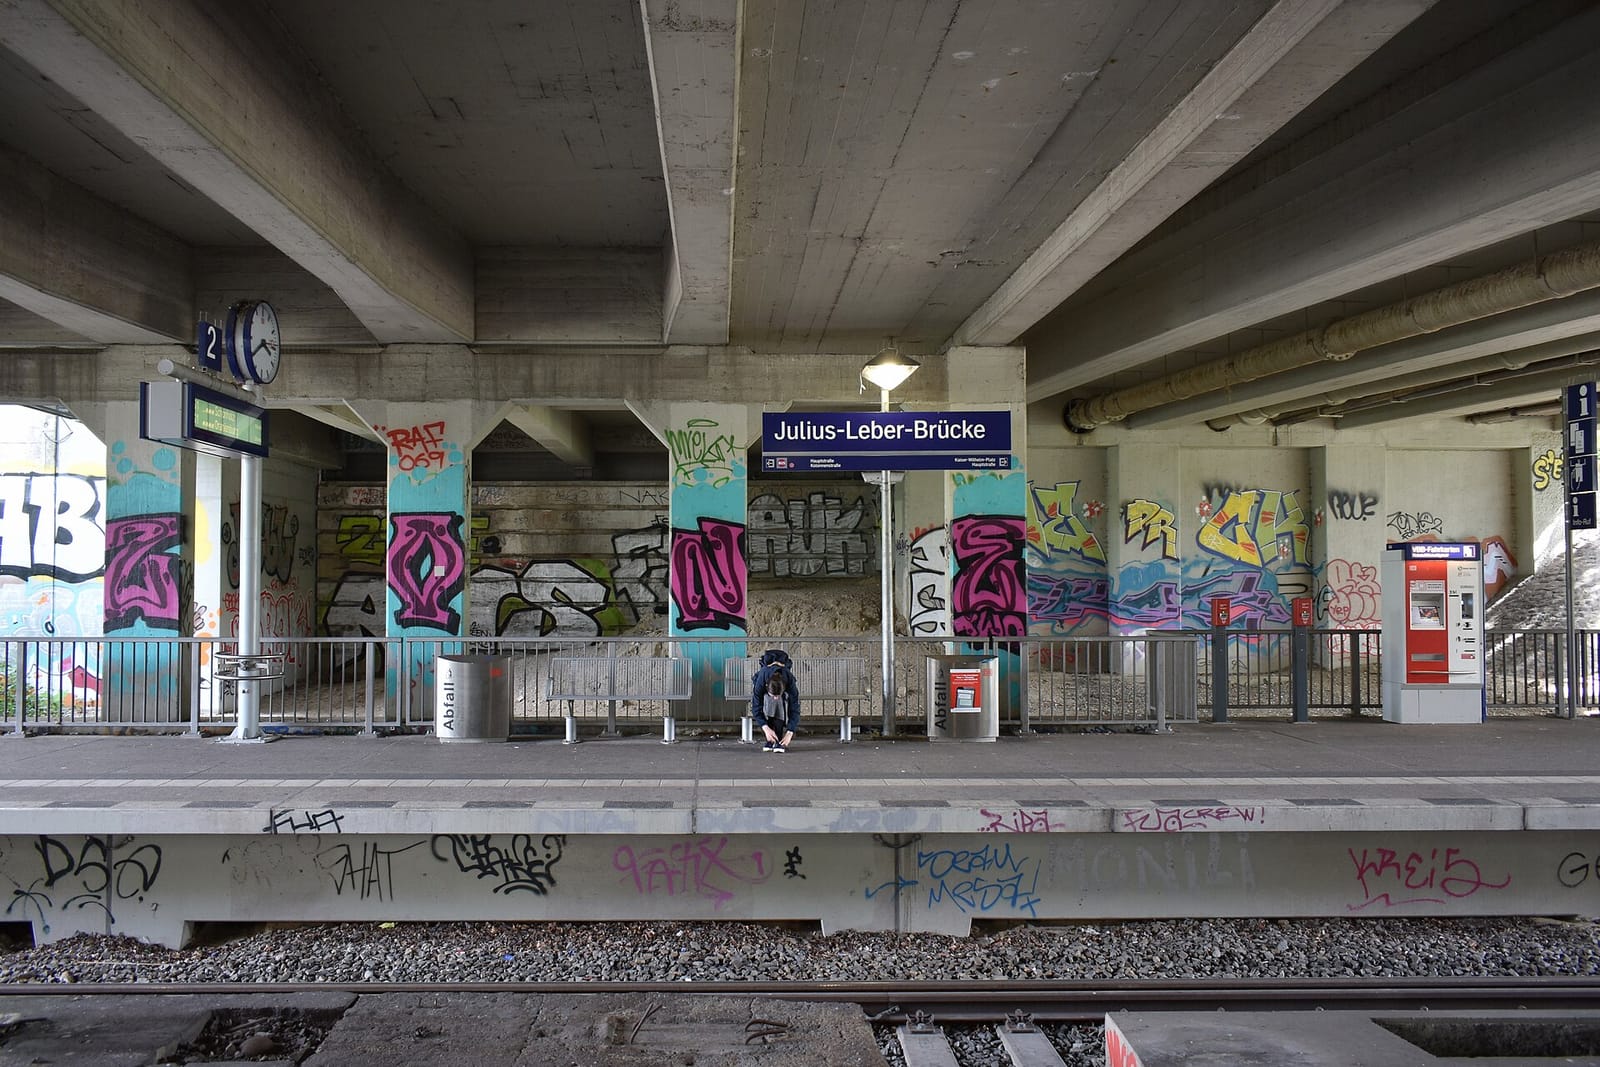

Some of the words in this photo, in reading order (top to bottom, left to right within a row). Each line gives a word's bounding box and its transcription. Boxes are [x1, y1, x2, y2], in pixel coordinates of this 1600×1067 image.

[206, 326, 216, 359] 2
[774, 419, 986, 440] Julius-Leber-Brücke
[443, 682, 455, 731] Abfall
[934, 682, 947, 730] Abfall
